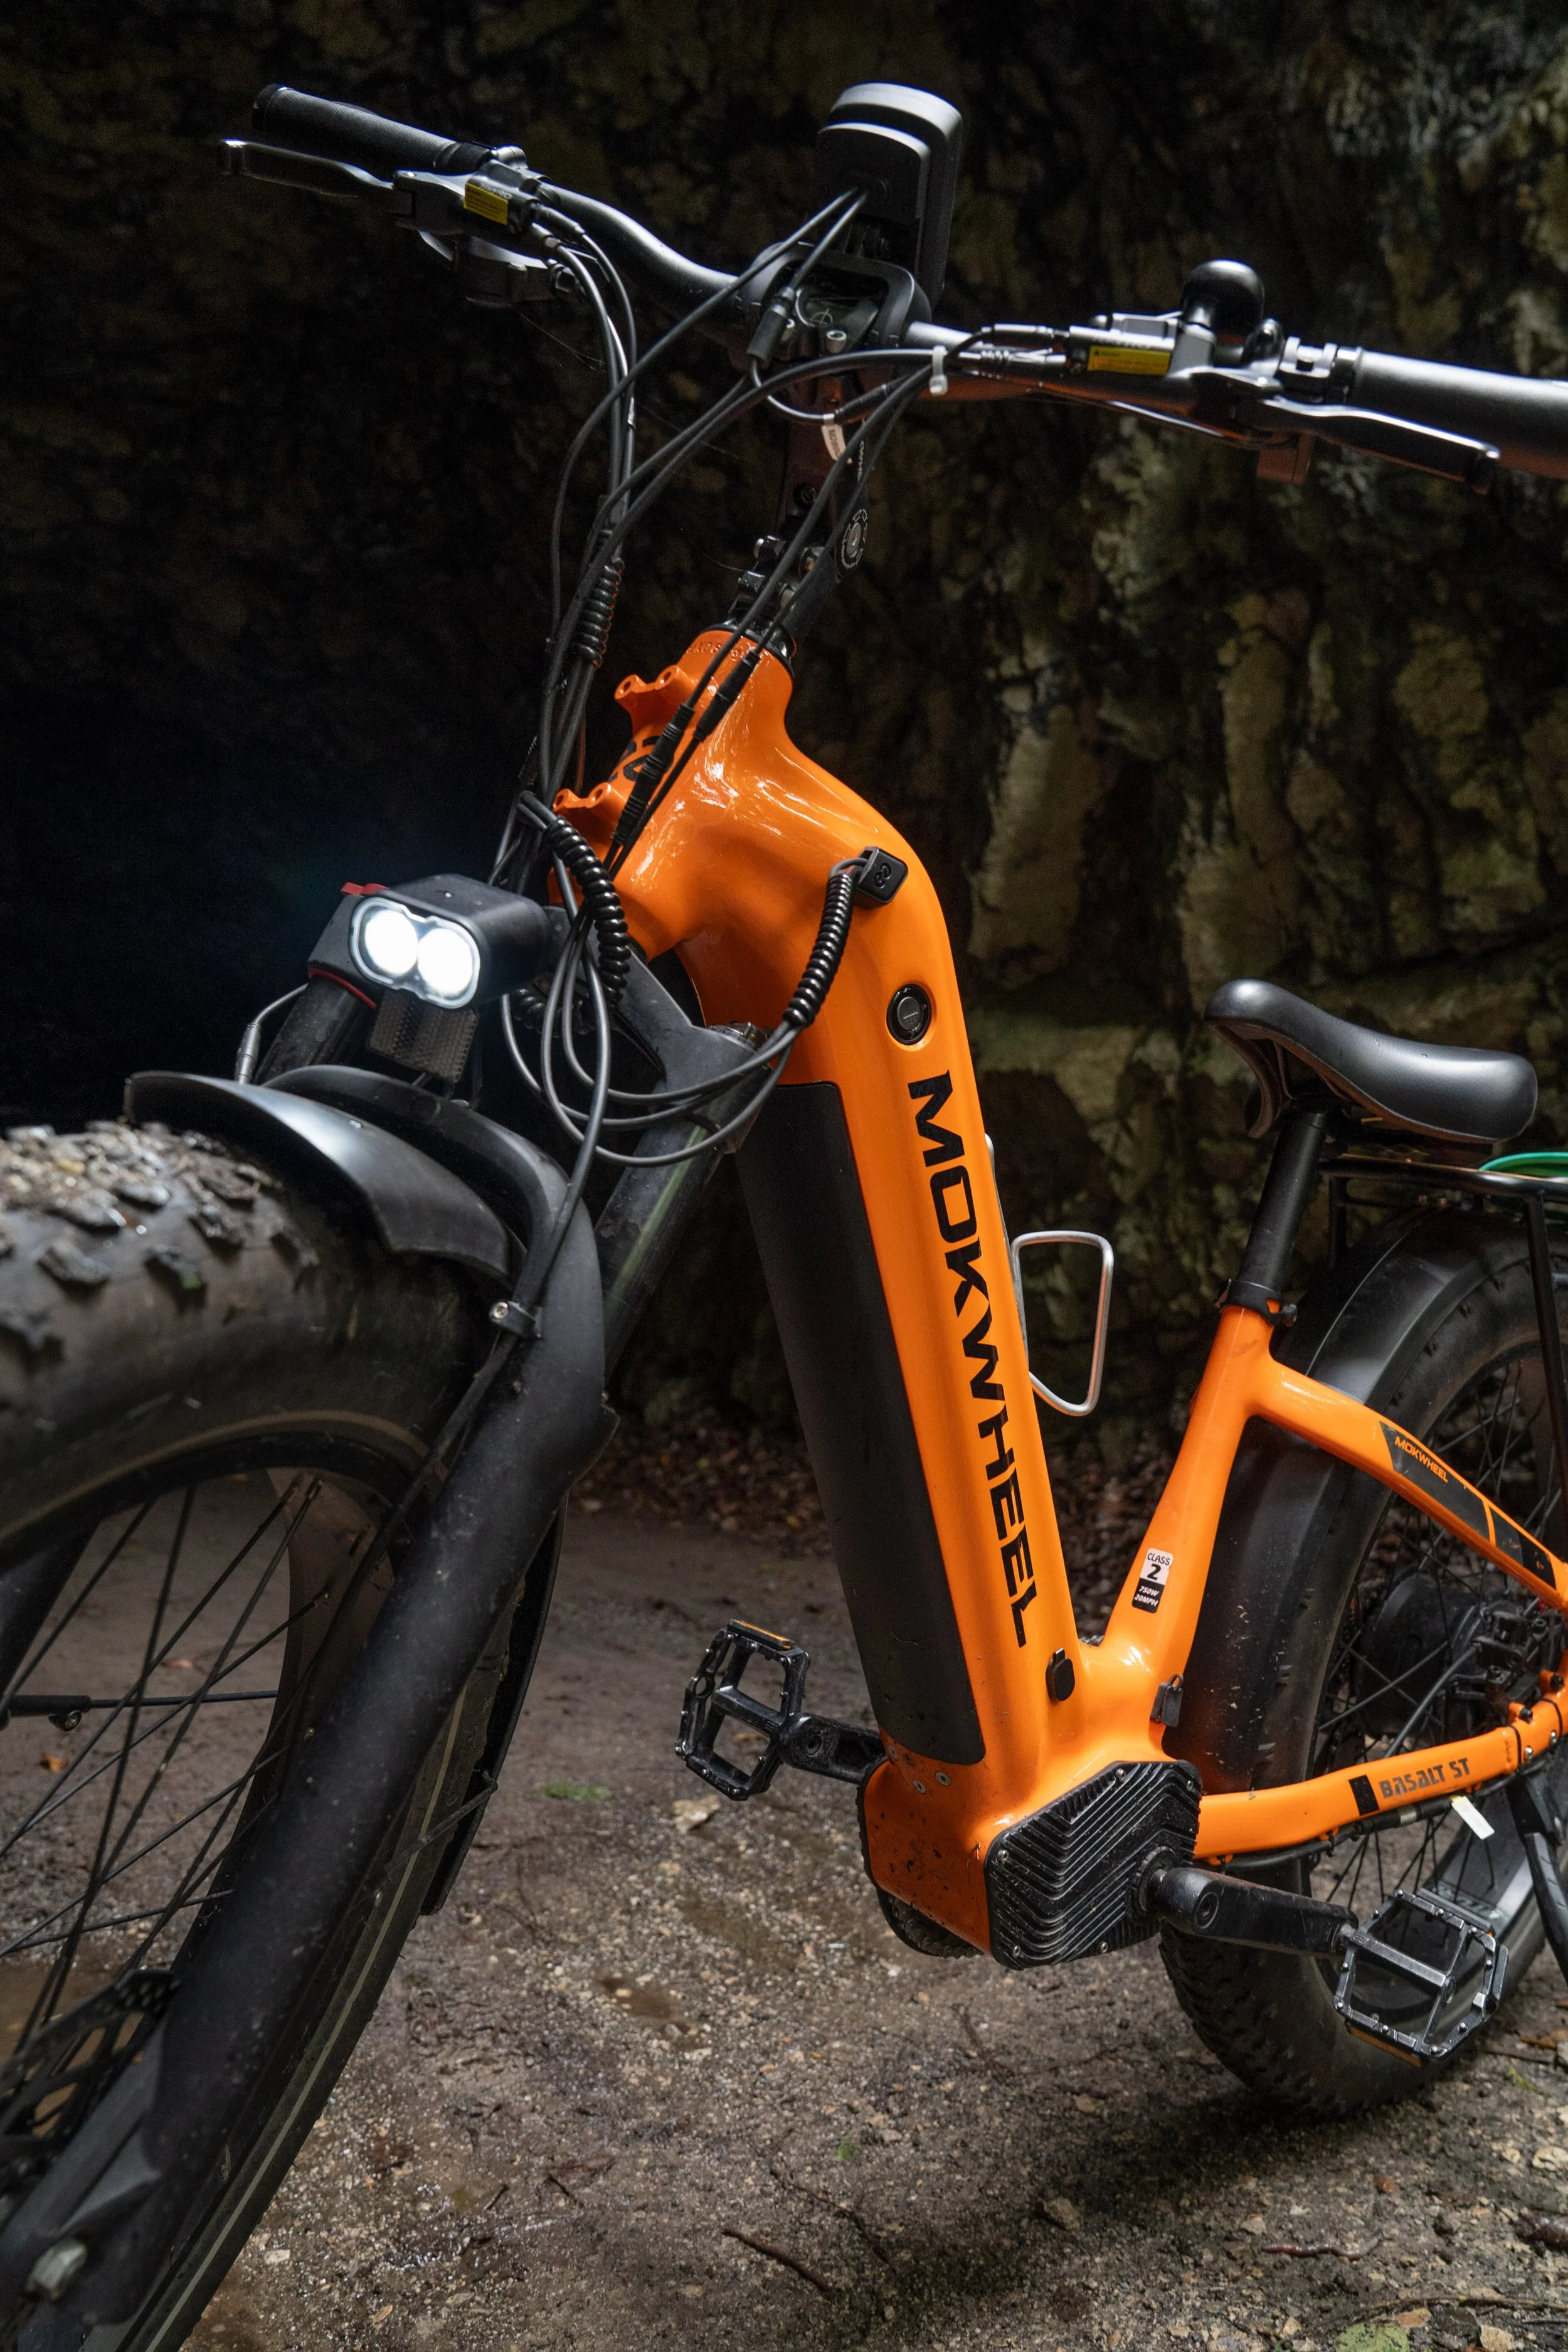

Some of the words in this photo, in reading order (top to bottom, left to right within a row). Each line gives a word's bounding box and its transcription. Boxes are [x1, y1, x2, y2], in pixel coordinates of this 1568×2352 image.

[907, 1069, 1038, 1648] MOKWHEEL
[1395, 1436, 1448, 1483] MOKWHEEL
[1147, 1552, 1170, 1565] CLASS
[1147, 1564, 1162, 1581] 2
[1134, 1594, 1159, 1606] 20MPH
[1139, 1586, 1160, 1597] 750W
[1379, 1764, 1445, 1798] BASALT
[1449, 1757, 1470, 1779] ST
